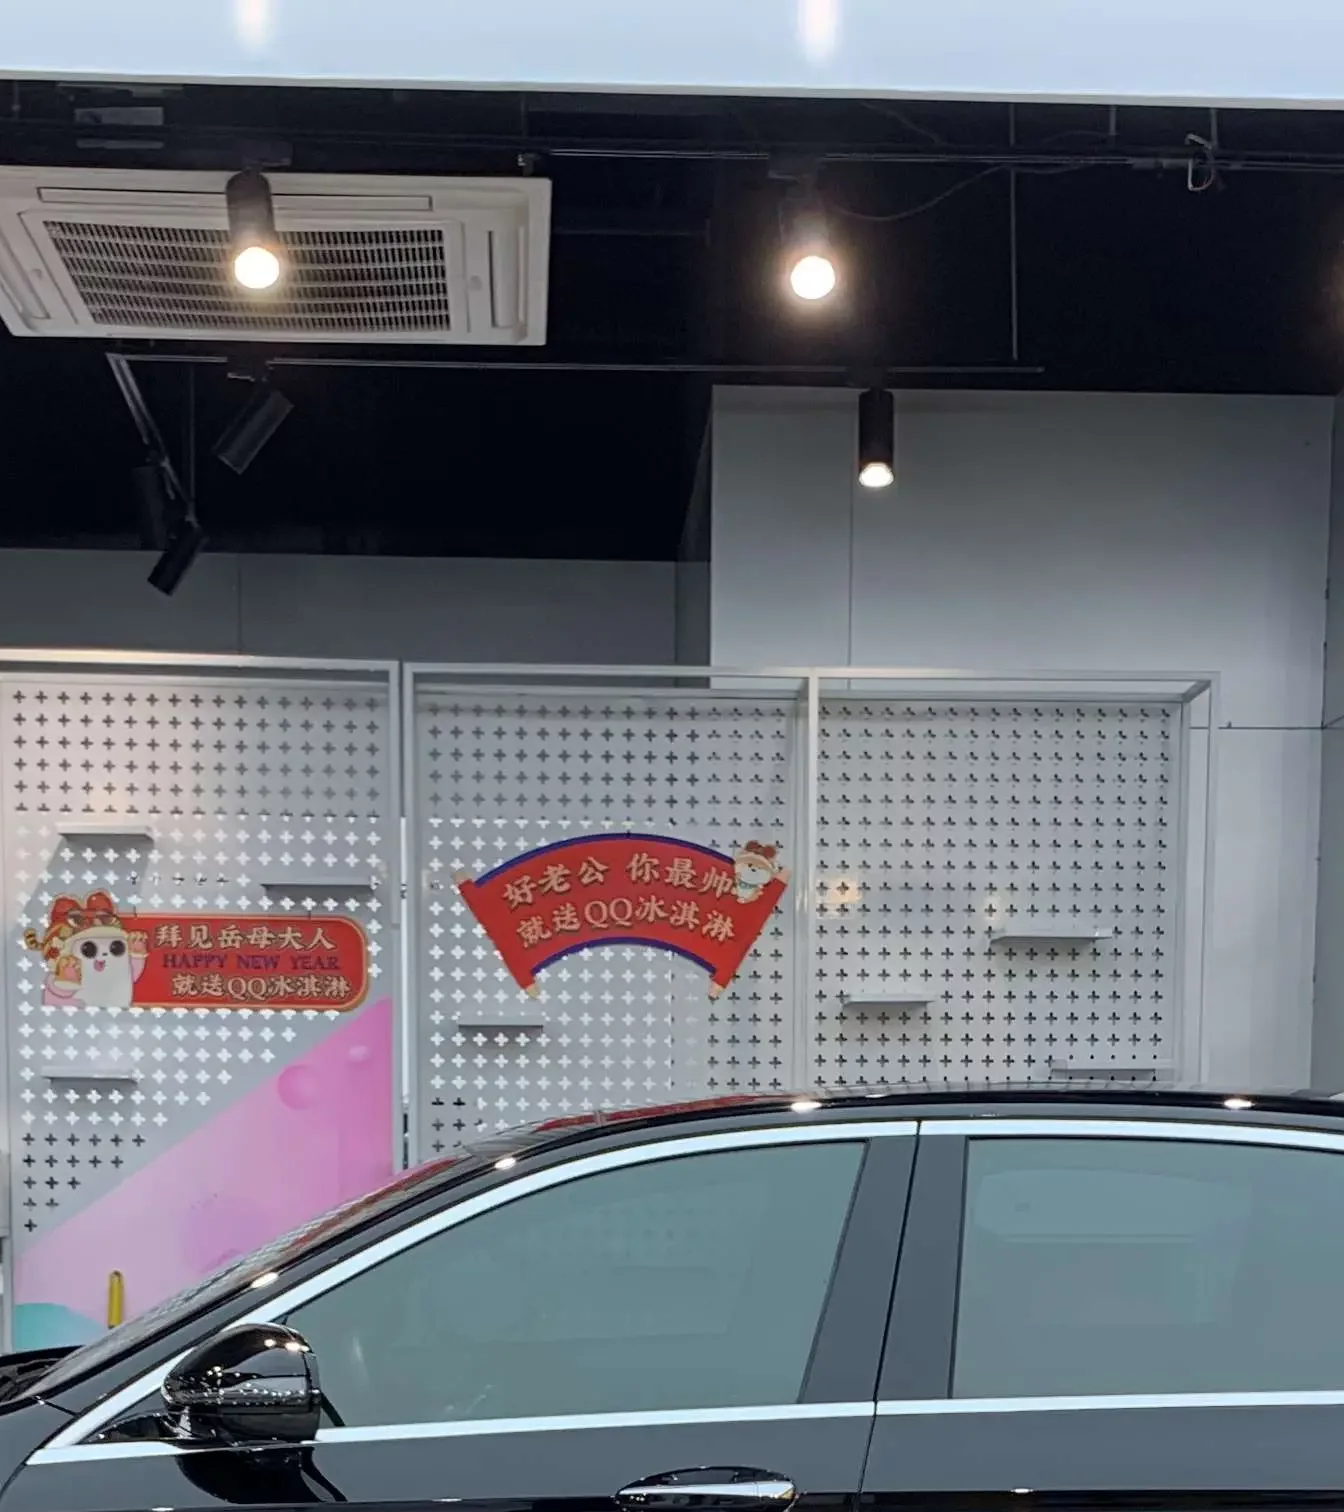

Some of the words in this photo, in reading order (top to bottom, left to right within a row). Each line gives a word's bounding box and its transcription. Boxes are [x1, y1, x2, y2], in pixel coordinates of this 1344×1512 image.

[503, 856, 608, 908] 好老公
[626, 852, 733, 899] 你最帅
[516, 895, 736, 949] 就送QQ冰淇淋
[155, 924, 336, 950] 拜见岳母大人
[163, 953, 228, 969] HAPPY
[236, 954, 281, 970] NEW
[291, 955, 341, 971] YEAR
[171, 973, 352, 1000] 就送QQ冰淇淋
